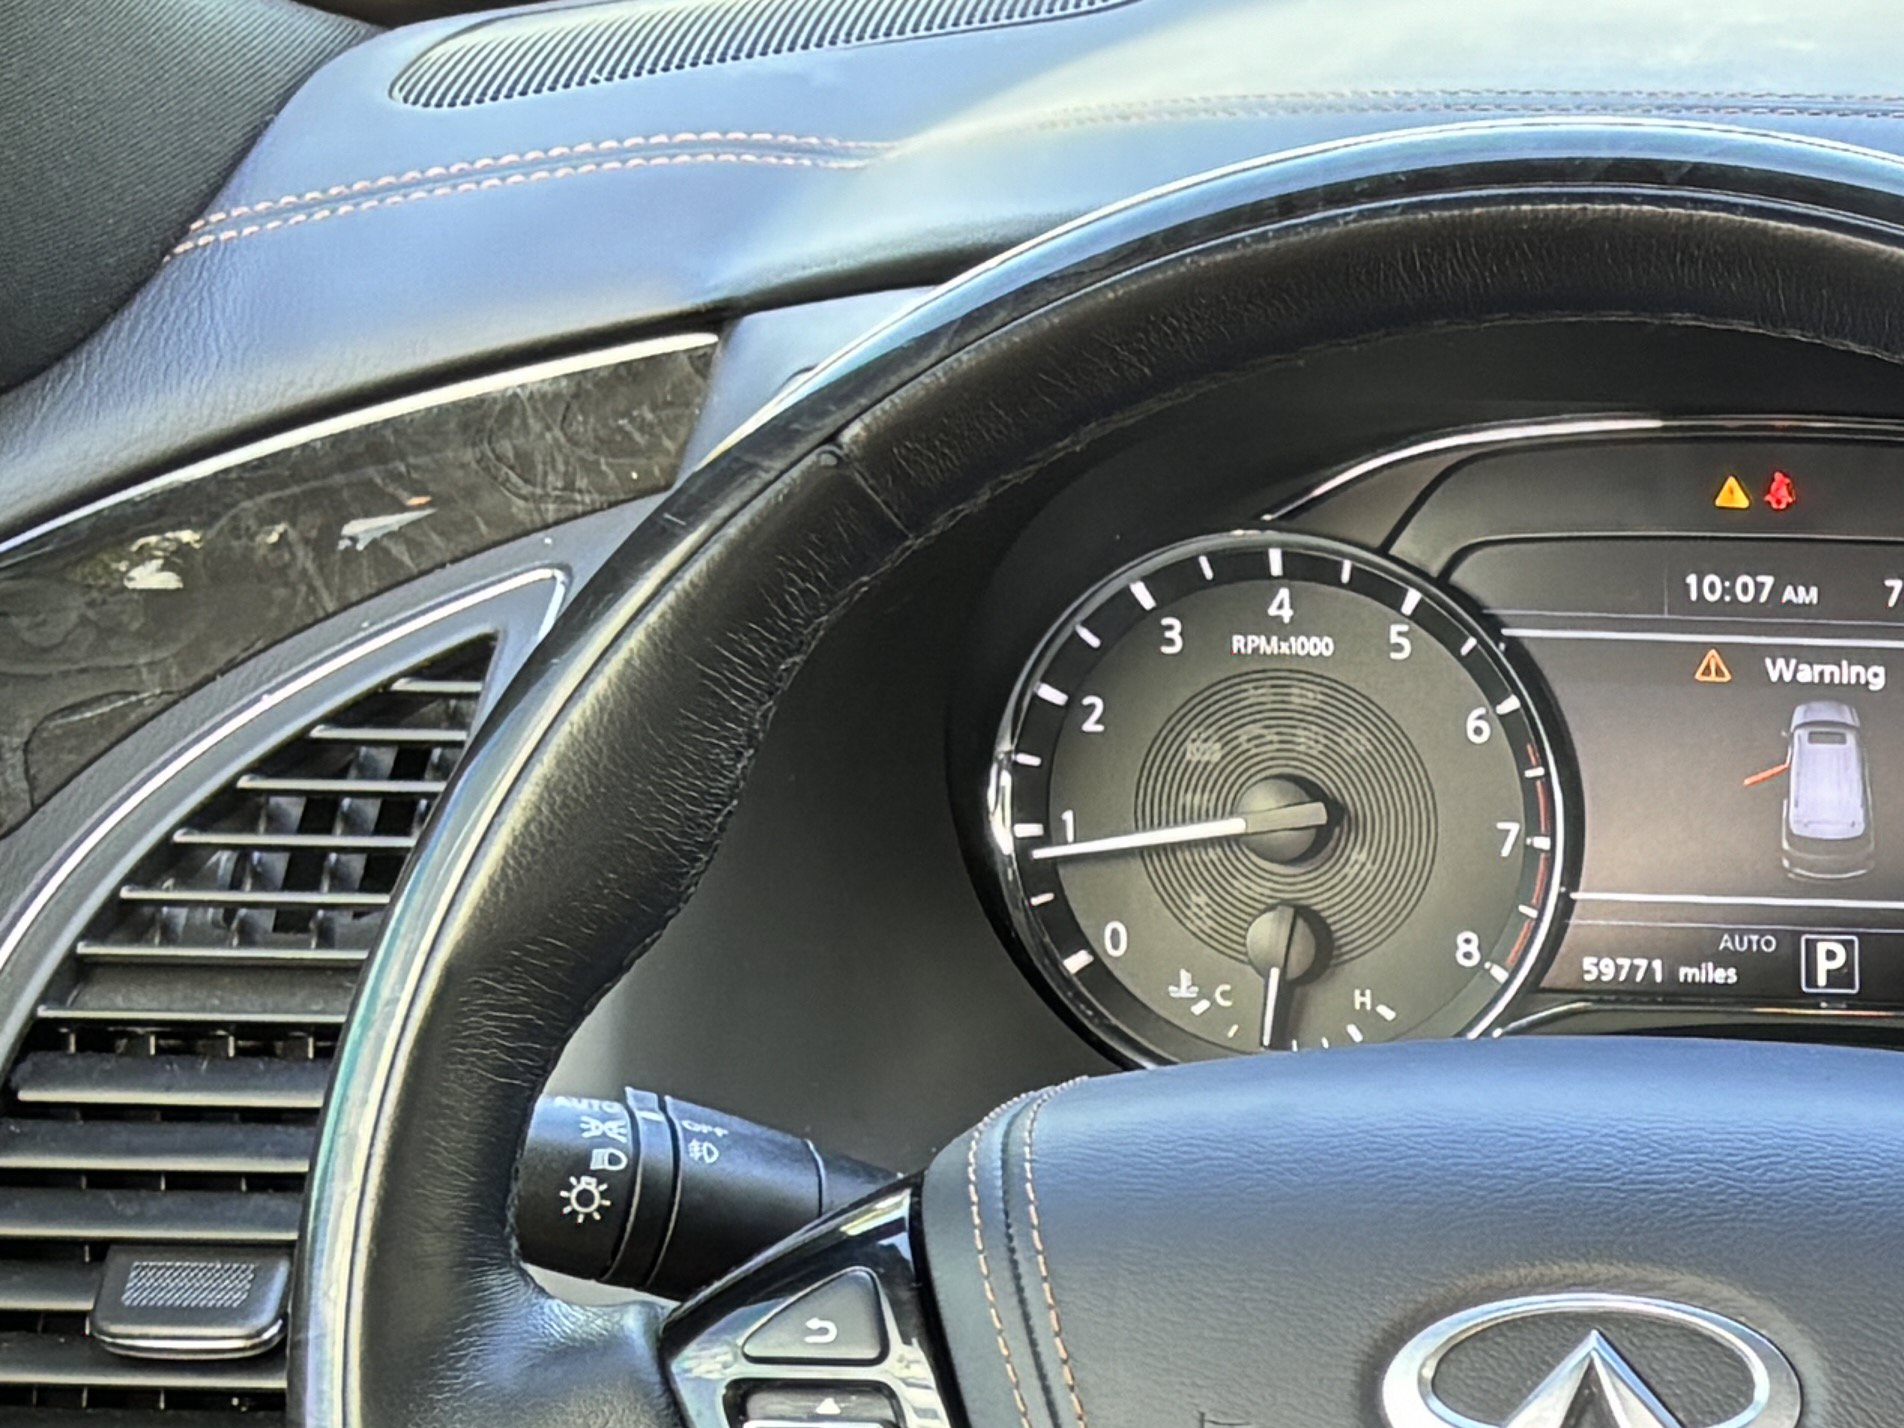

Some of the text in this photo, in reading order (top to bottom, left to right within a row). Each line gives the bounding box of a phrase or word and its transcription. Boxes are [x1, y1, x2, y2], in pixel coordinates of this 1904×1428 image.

[1268, 588, 1294, 623] 4
[1685, 574, 1819, 605] 10:07 AM
[1160, 619, 1184, 654] 3
[1231, 635, 1335, 657] RPMx1000
[1389, 625, 1412, 660] 5
[1764, 659, 1887, 691] Warning
[1081, 696, 1105, 733] 2
[1466, 707, 1492, 745] 6
[1060, 809, 1076, 842] 1
[1496, 822, 1521, 857] 7
[1104, 921, 1129, 957] 0
[1455, 931, 1482, 967] 8
[1718, 934, 1777, 953] AUTO
[1582, 957, 1738, 985] 59771 miles
[1816, 943, 1847, 987] P
[1215, 985, 1232, 1007] C
[1354, 989, 1372, 1010] H
